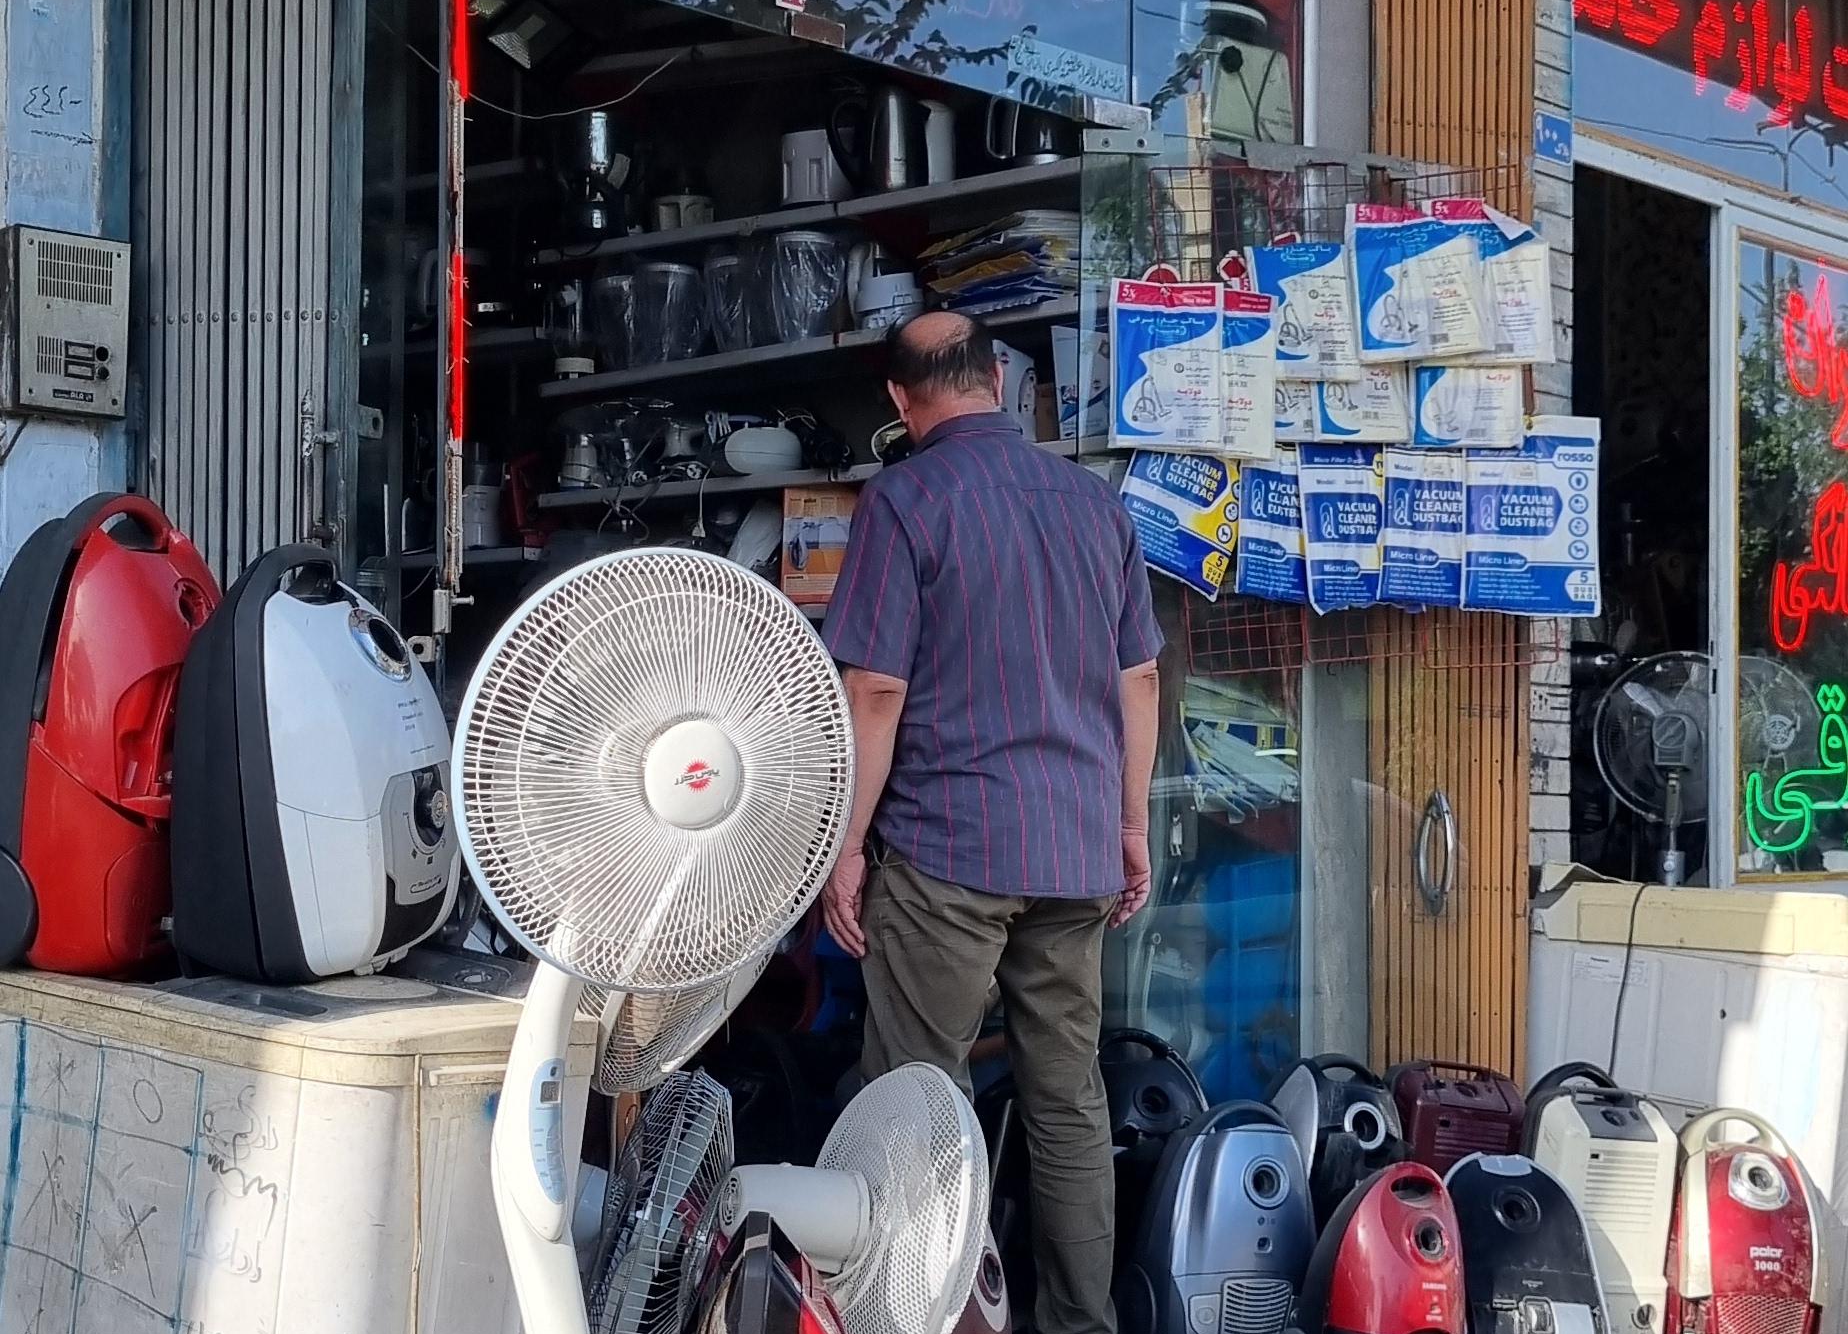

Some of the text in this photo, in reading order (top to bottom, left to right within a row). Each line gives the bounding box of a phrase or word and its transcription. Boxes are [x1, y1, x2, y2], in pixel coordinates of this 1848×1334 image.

[1374, 381, 1389, 392] LG
[1557, 453, 1594, 463] rosso
[1169, 462, 1218, 492] CLEANER
[1165, 472, 1214, 502] DUSTBAG
[1501, 493, 1554, 506] VACUUM
[1500, 506, 1554, 517] CLEANER
[1499, 516, 1554, 528] DUSTBAG
[1215, 555, 1224, 567] 5
[1579, 571, 1589, 584] 5
[1749, 1245, 1783, 1259] polar
